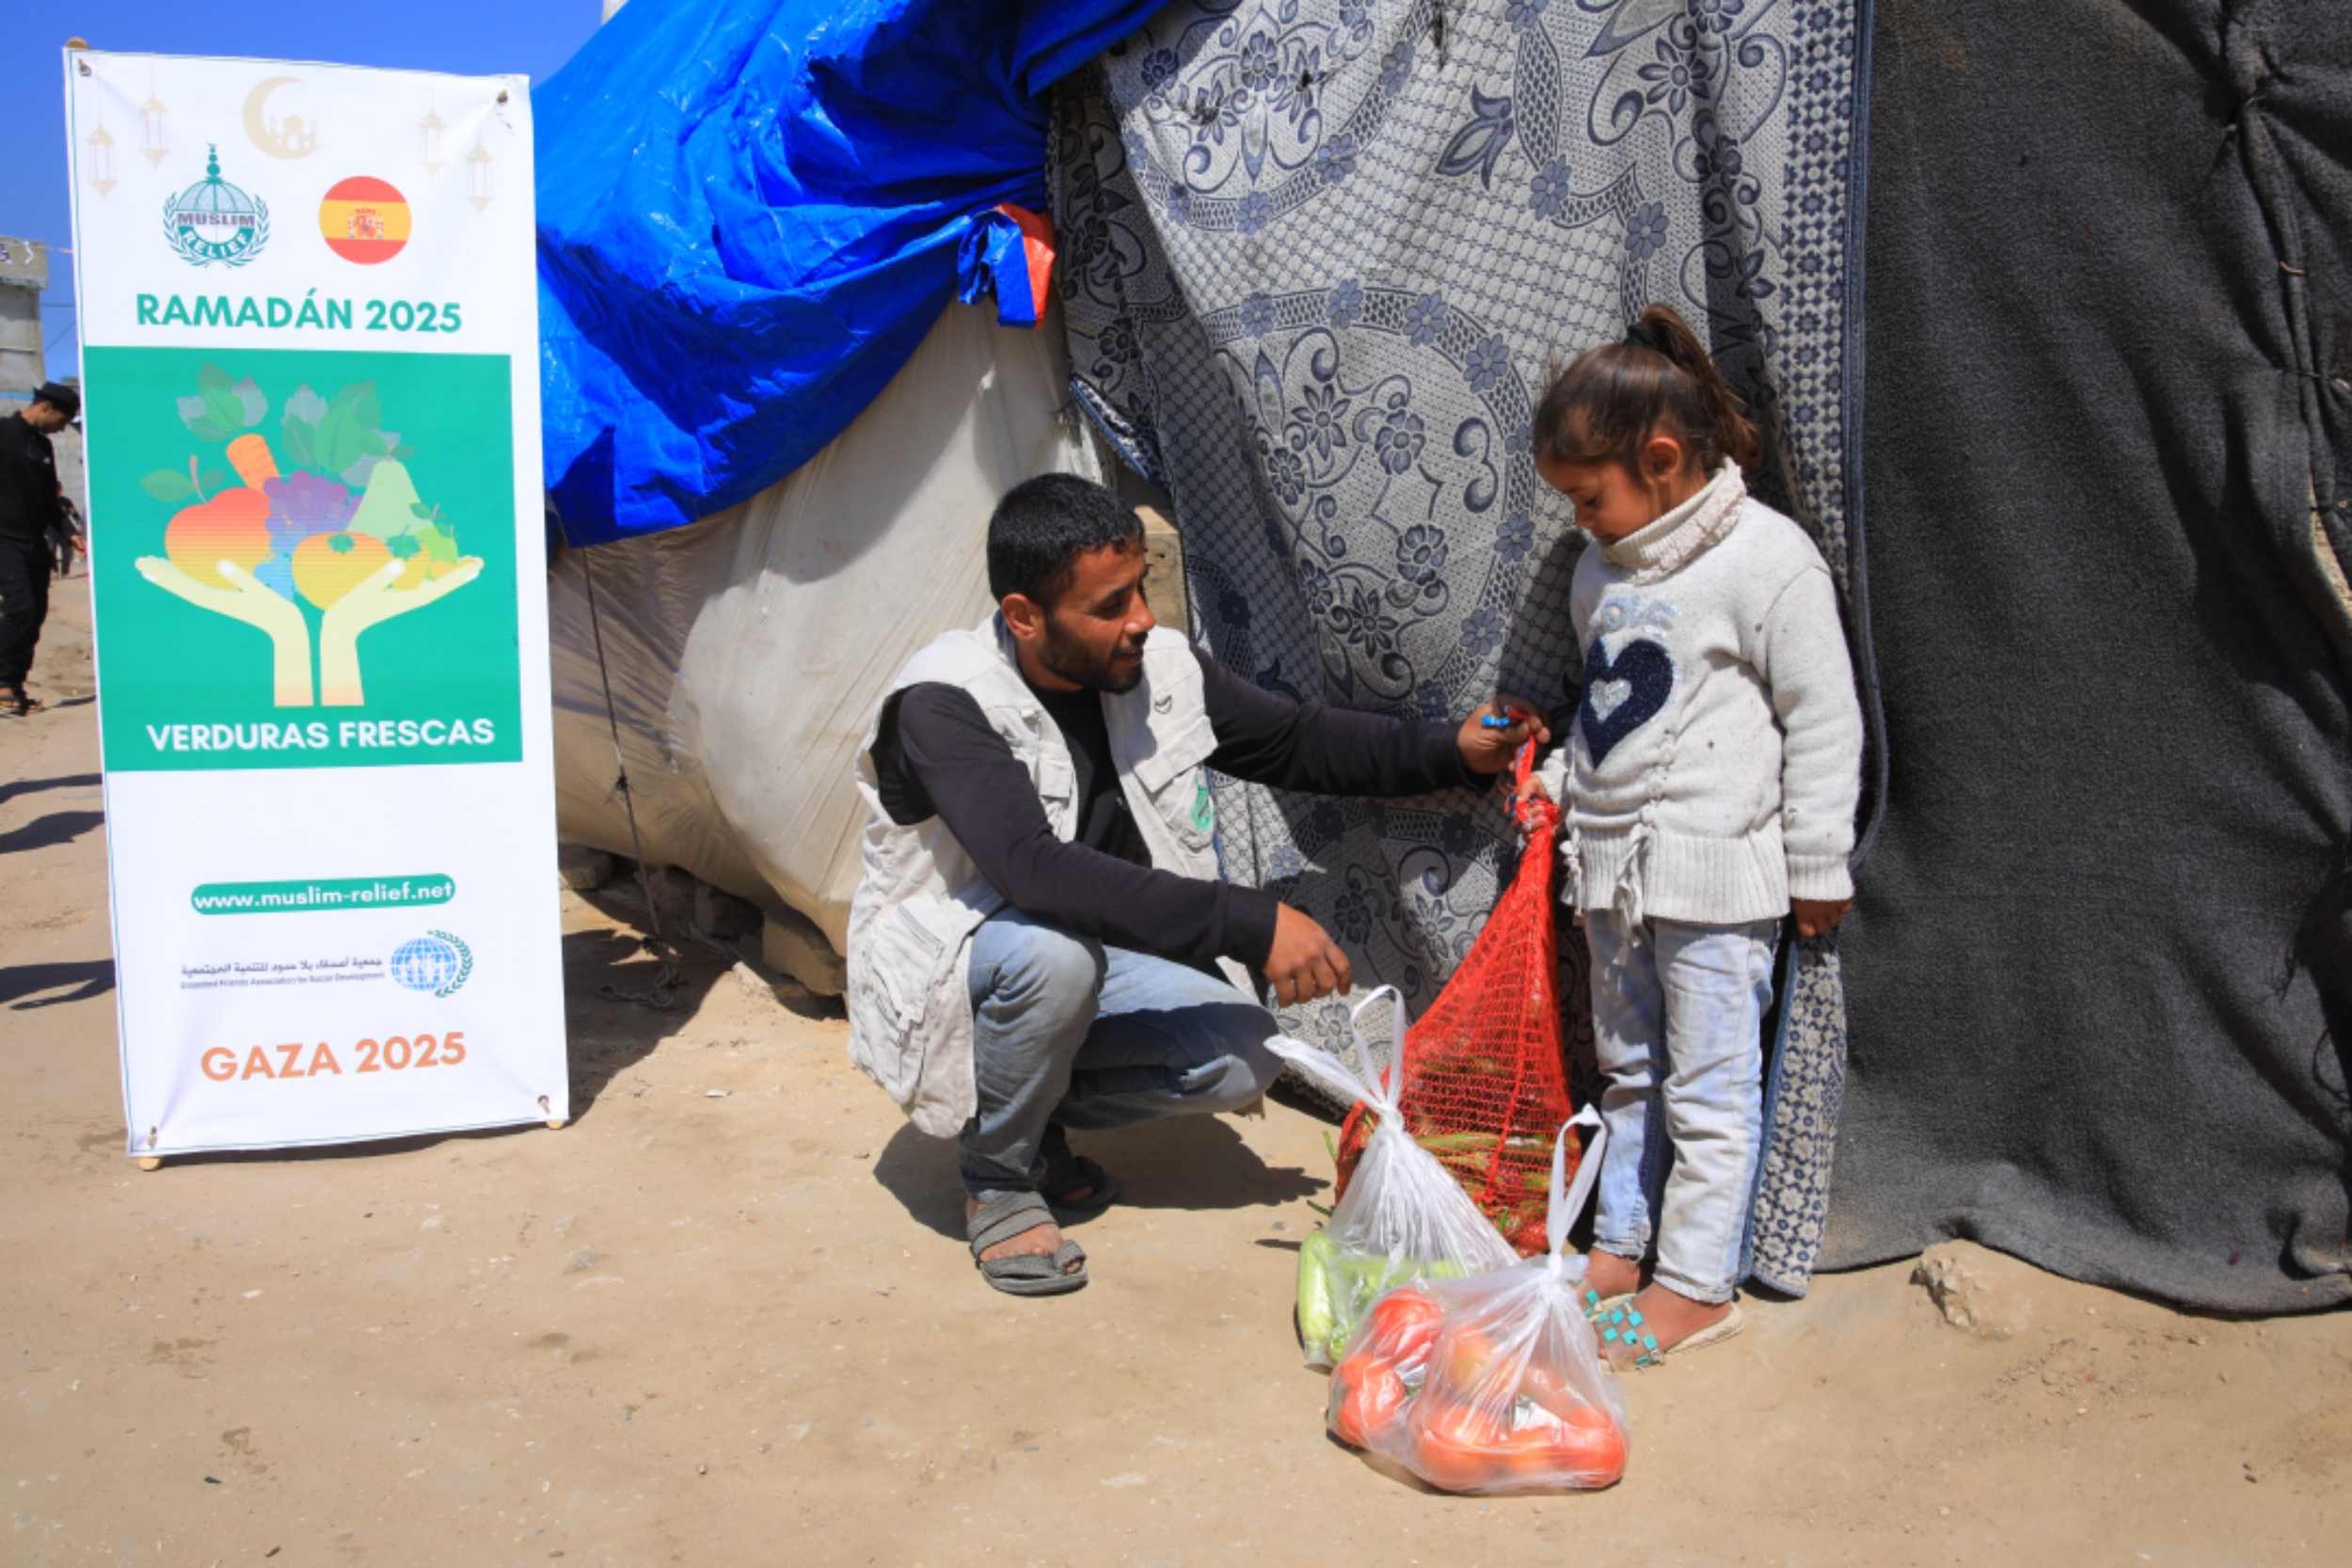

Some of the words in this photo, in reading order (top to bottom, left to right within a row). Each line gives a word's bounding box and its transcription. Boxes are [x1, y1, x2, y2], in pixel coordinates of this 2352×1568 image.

[177, 213, 256, 226] MUSLIM
[181, 230, 251, 259] RELIEF
[136, 288, 353, 329] RAMADÁN
[365, 300, 462, 333] 2025
[147, 722, 329, 752] VERDURAS
[340, 719, 495, 748] FRESCAS
[194, 880, 453, 911] www.muslim-relief.net
[201, 1042, 341, 1081] GAZA
[357, 1032, 466, 1071] 2025
